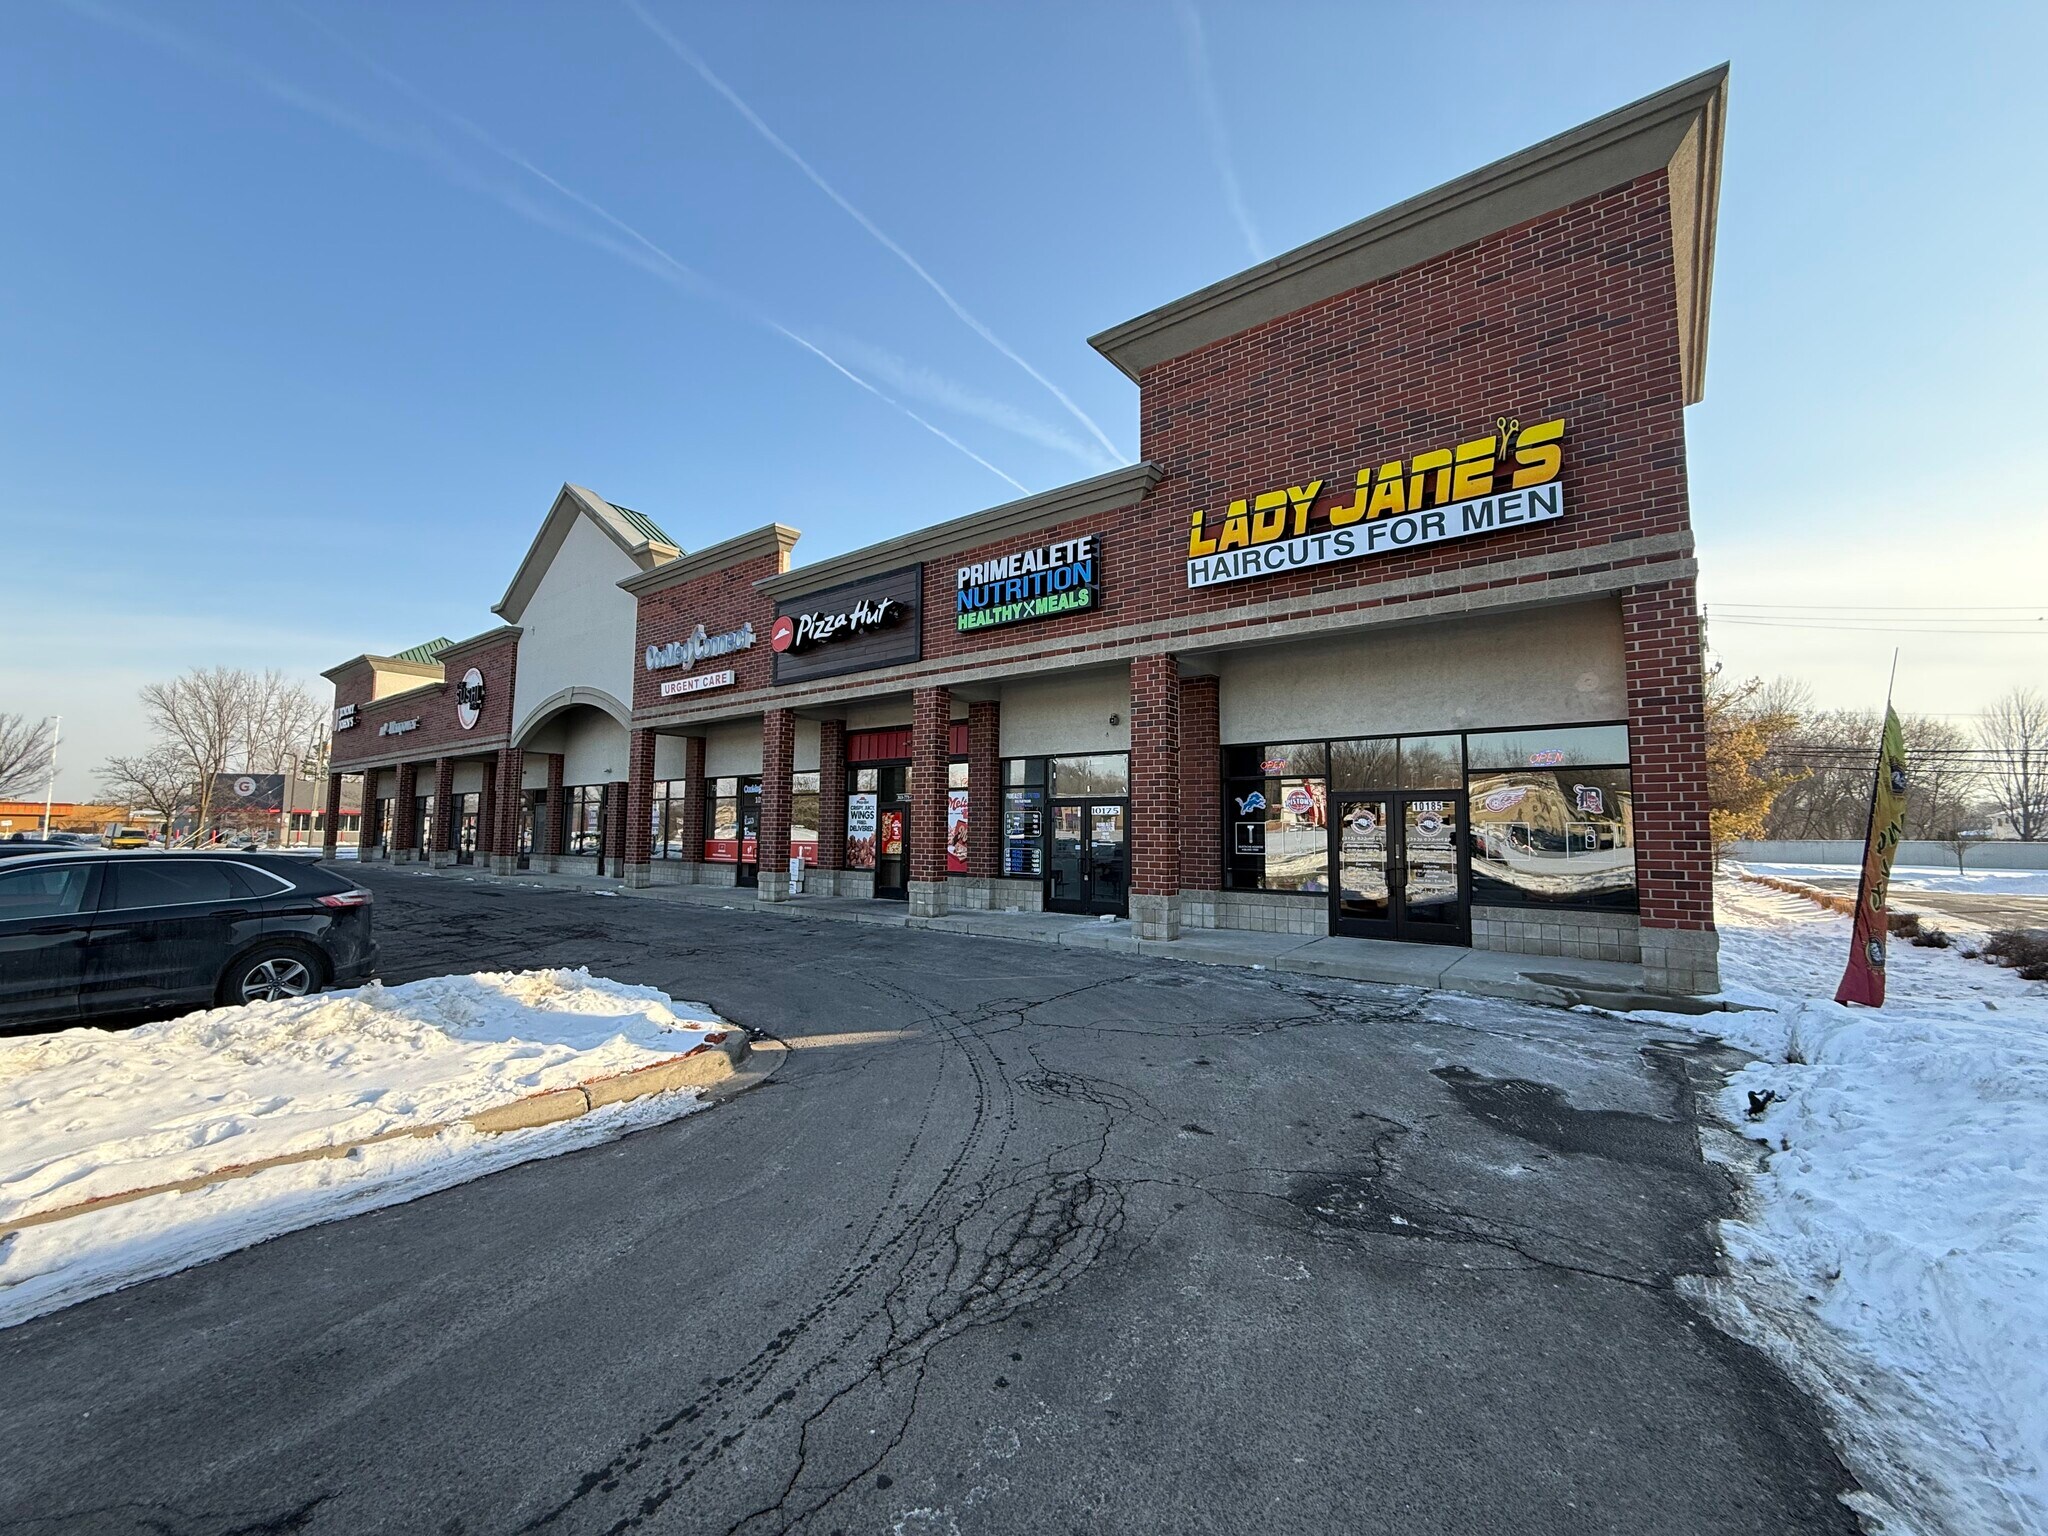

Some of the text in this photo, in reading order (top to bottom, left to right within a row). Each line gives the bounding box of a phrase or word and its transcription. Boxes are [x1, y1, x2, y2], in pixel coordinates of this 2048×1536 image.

[1188, 418, 1566, 559] LADY JANE'S
[1190, 485, 1558, 585] HAIRCUTS FOR MEN
[957, 535, 1093, 589] PRIMEALETE
[957, 559, 1092, 611] NUTRITION
[796, 597, 895, 646] Pizza Hut
[957, 588, 1090, 630] HEALTHY MEALS
[455, 684, 480, 704] SUSHI
[664, 673, 728, 694] URGENT CARE
[1260, 760, 1286, 770] OPEN
[1528, 752, 1564, 765] OPEN
[850, 810, 875, 820] WINGS
[1413, 801, 1443, 811] 10185
